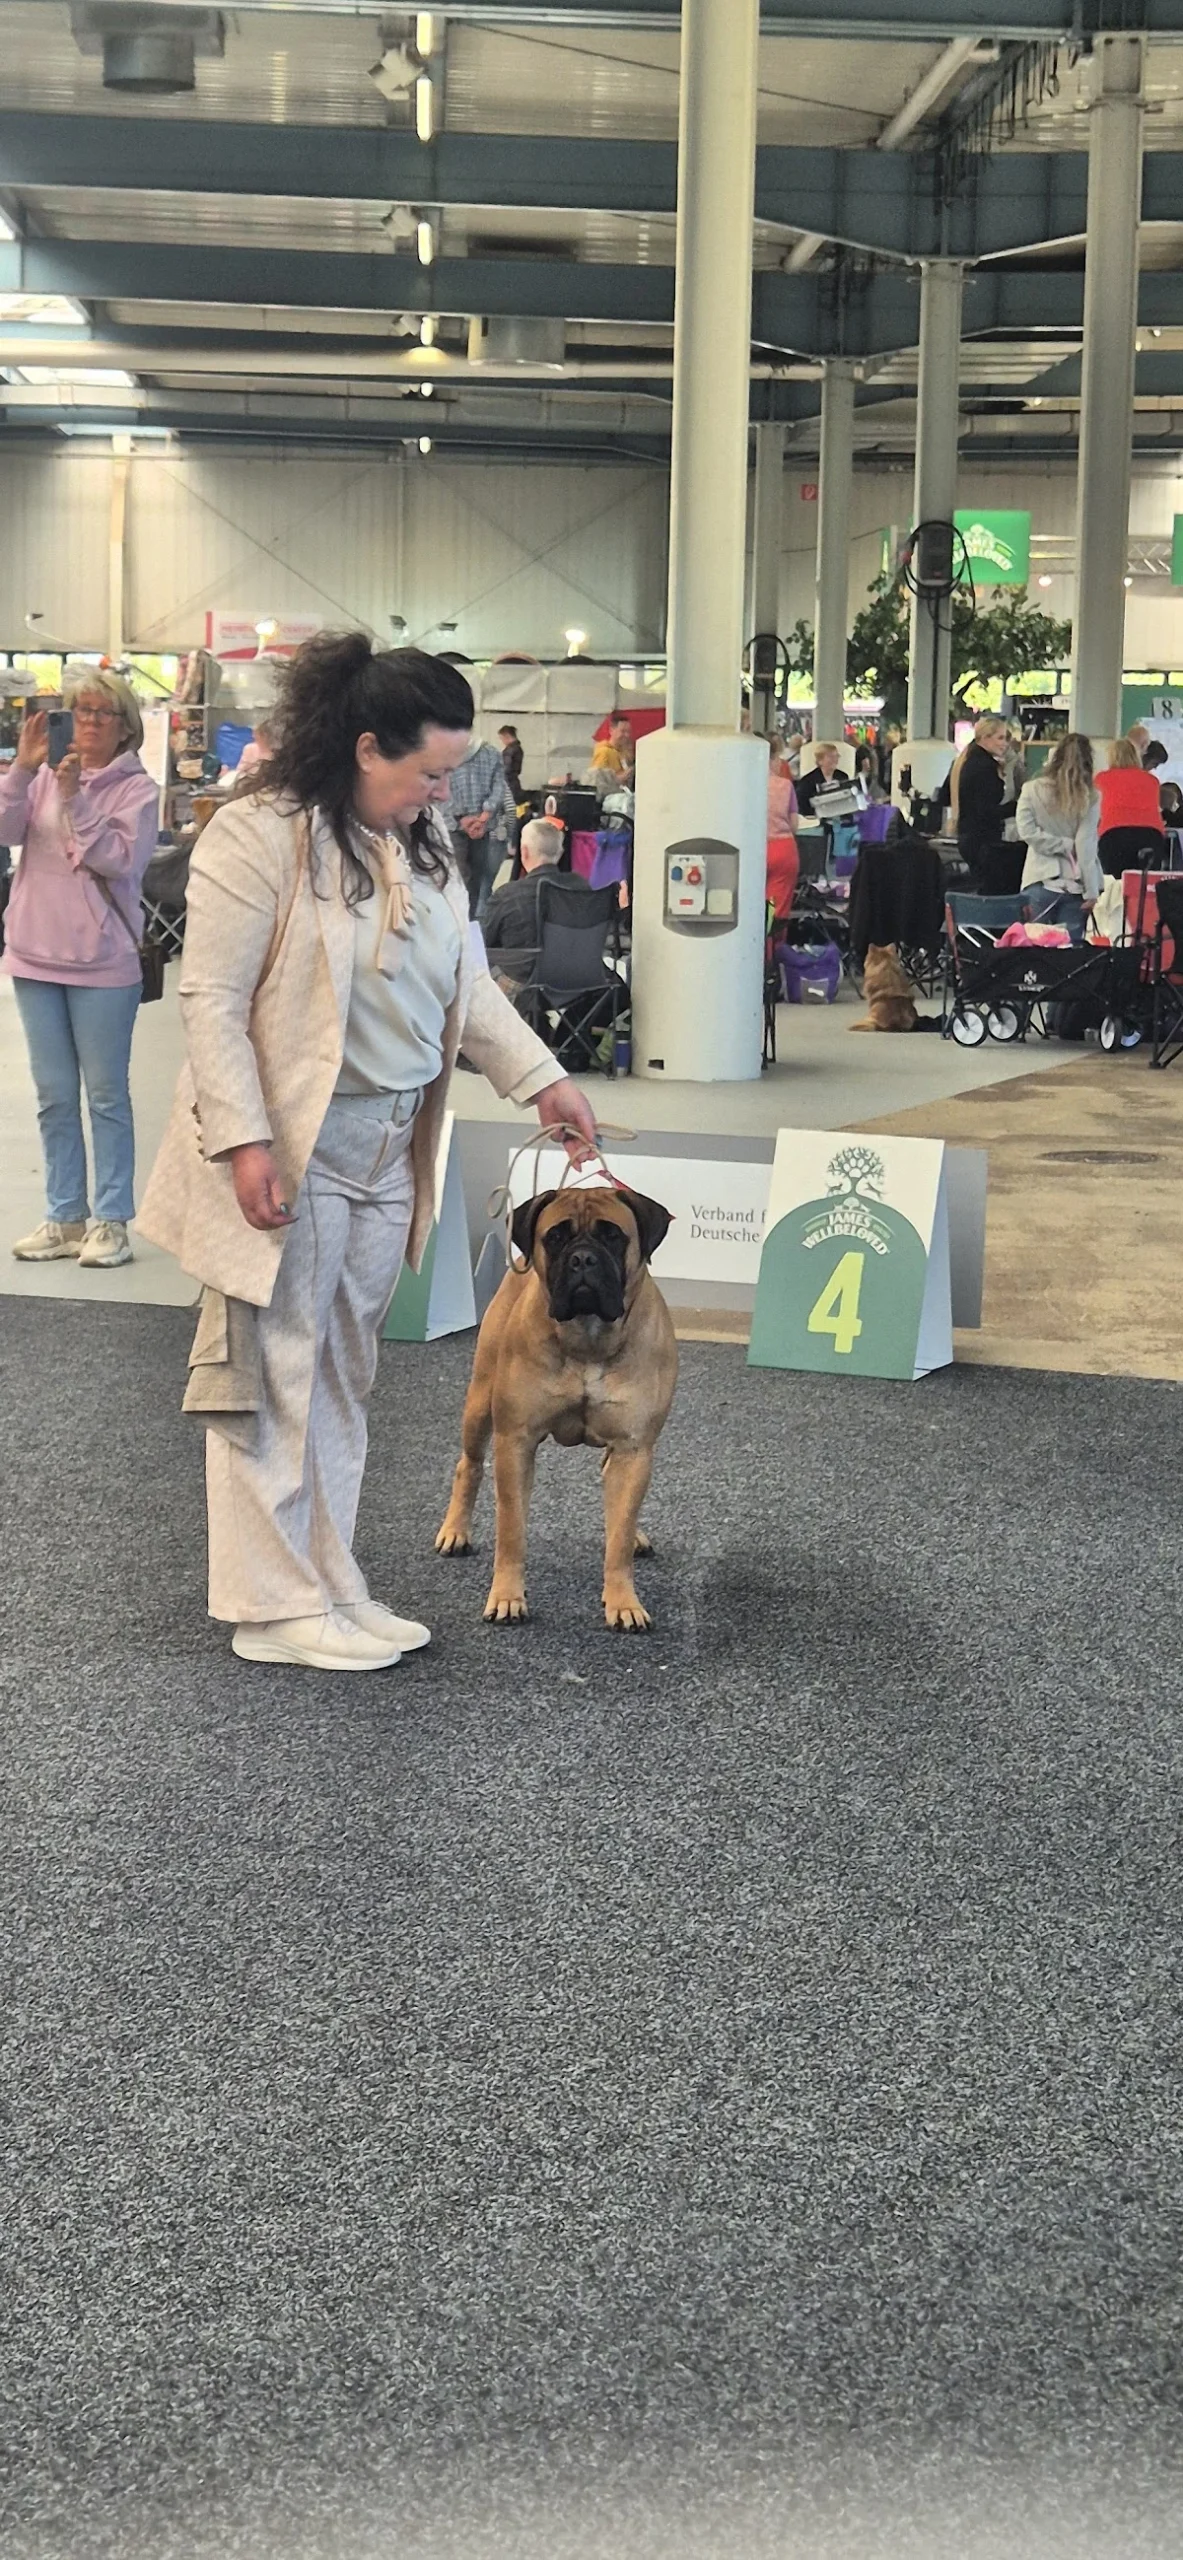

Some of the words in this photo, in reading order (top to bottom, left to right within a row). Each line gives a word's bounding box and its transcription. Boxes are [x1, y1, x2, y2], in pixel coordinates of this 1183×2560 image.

[1161, 699, 1174, 720] 8
[691, 1205, 755, 1223] Verband
[828, 1212, 872, 1228] JAMES
[690, 1224, 761, 1243] Deutsche
[801, 1223, 888, 1255] WELLBELOVED
[807, 1251, 865, 1353] 4
